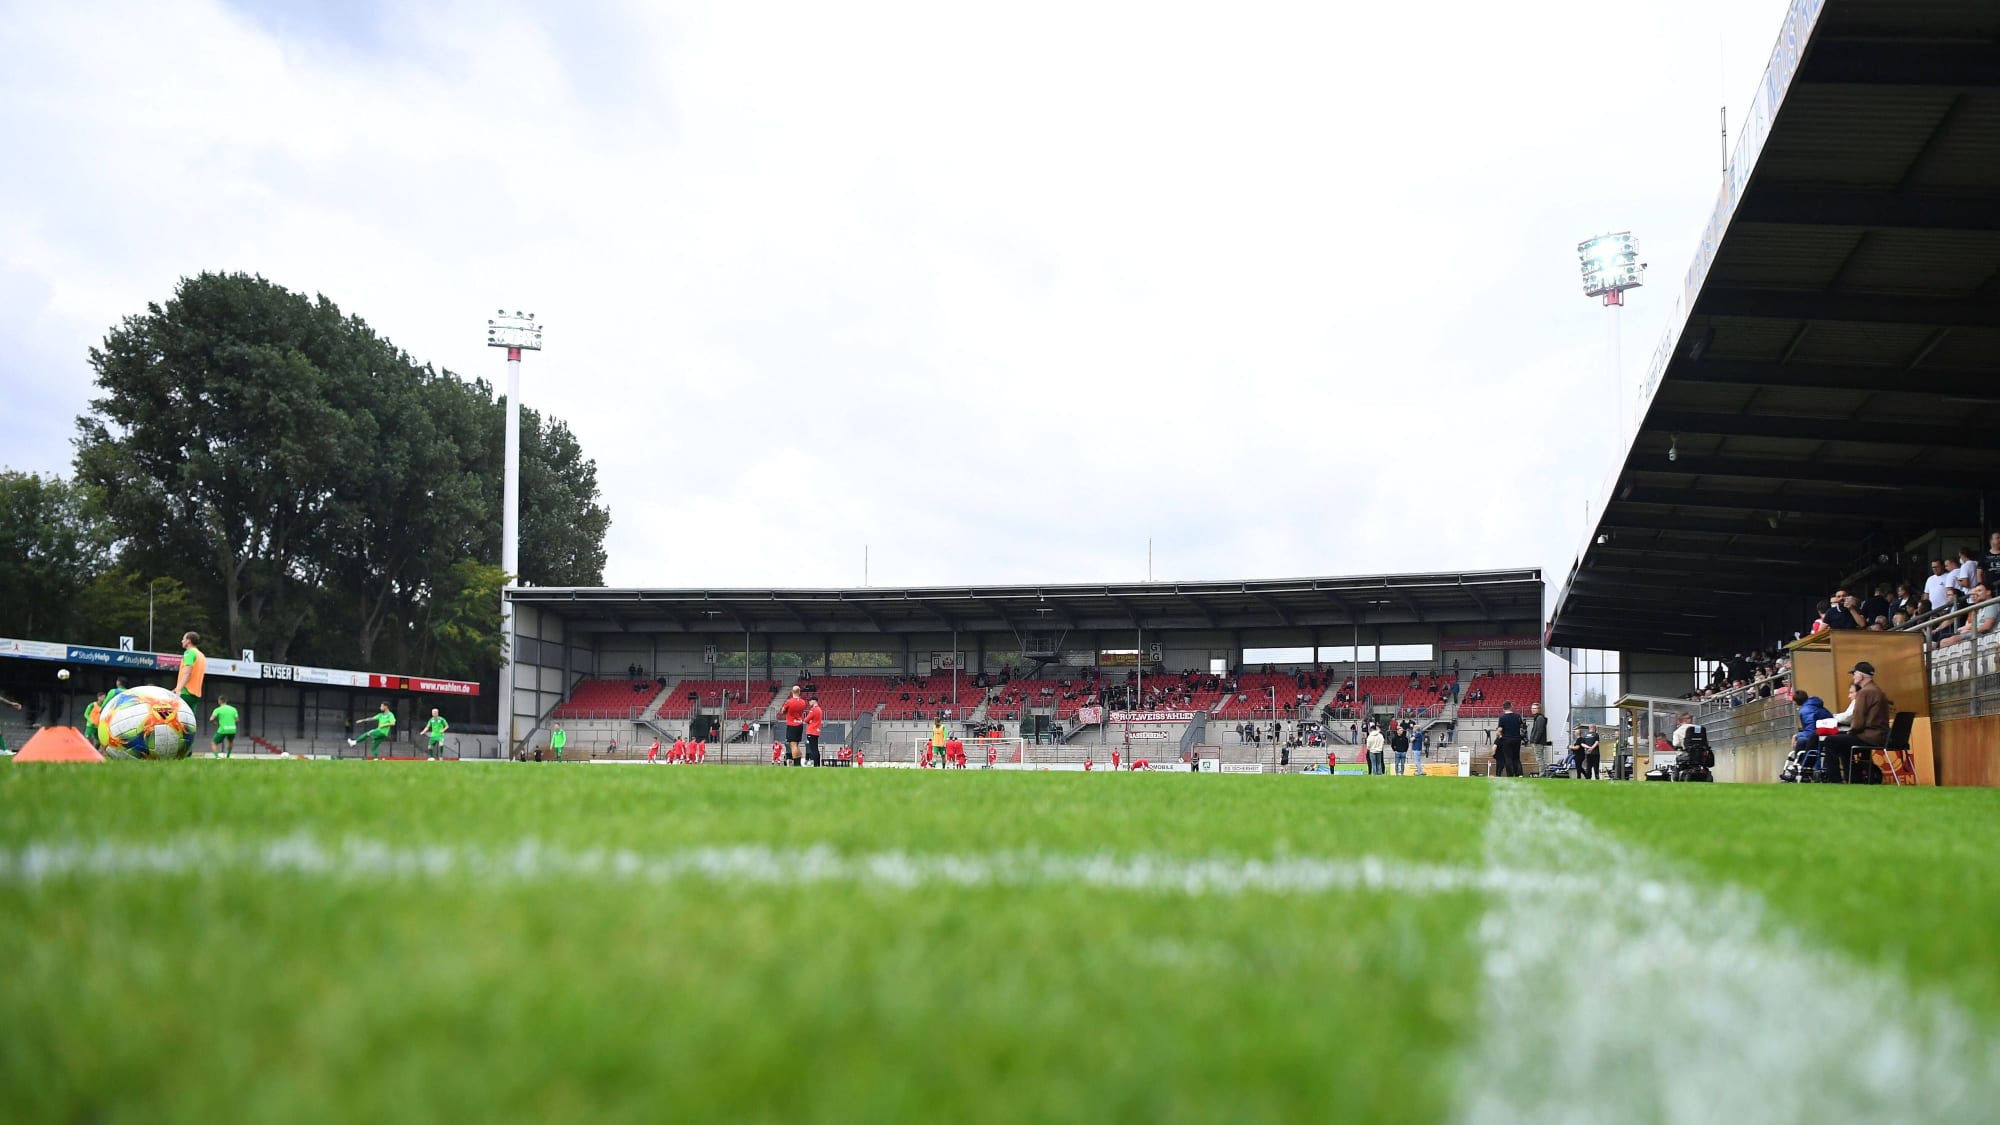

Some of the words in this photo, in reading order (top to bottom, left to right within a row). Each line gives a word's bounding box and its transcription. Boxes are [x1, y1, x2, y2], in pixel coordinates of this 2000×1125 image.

[121, 638, 131, 651] K
[705, 645, 716, 654] H1
[1151, 643, 1162, 651] G1
[78, 650, 111, 663] StudyHelp
[124, 655, 154, 667] StudyHelp
[243, 652, 251, 663] K
[707, 654, 714, 662] H
[1152, 652, 1160, 661] G
[263, 665, 293, 680] SLYSER
[420, 682, 470, 693] www.rwahlen.de
